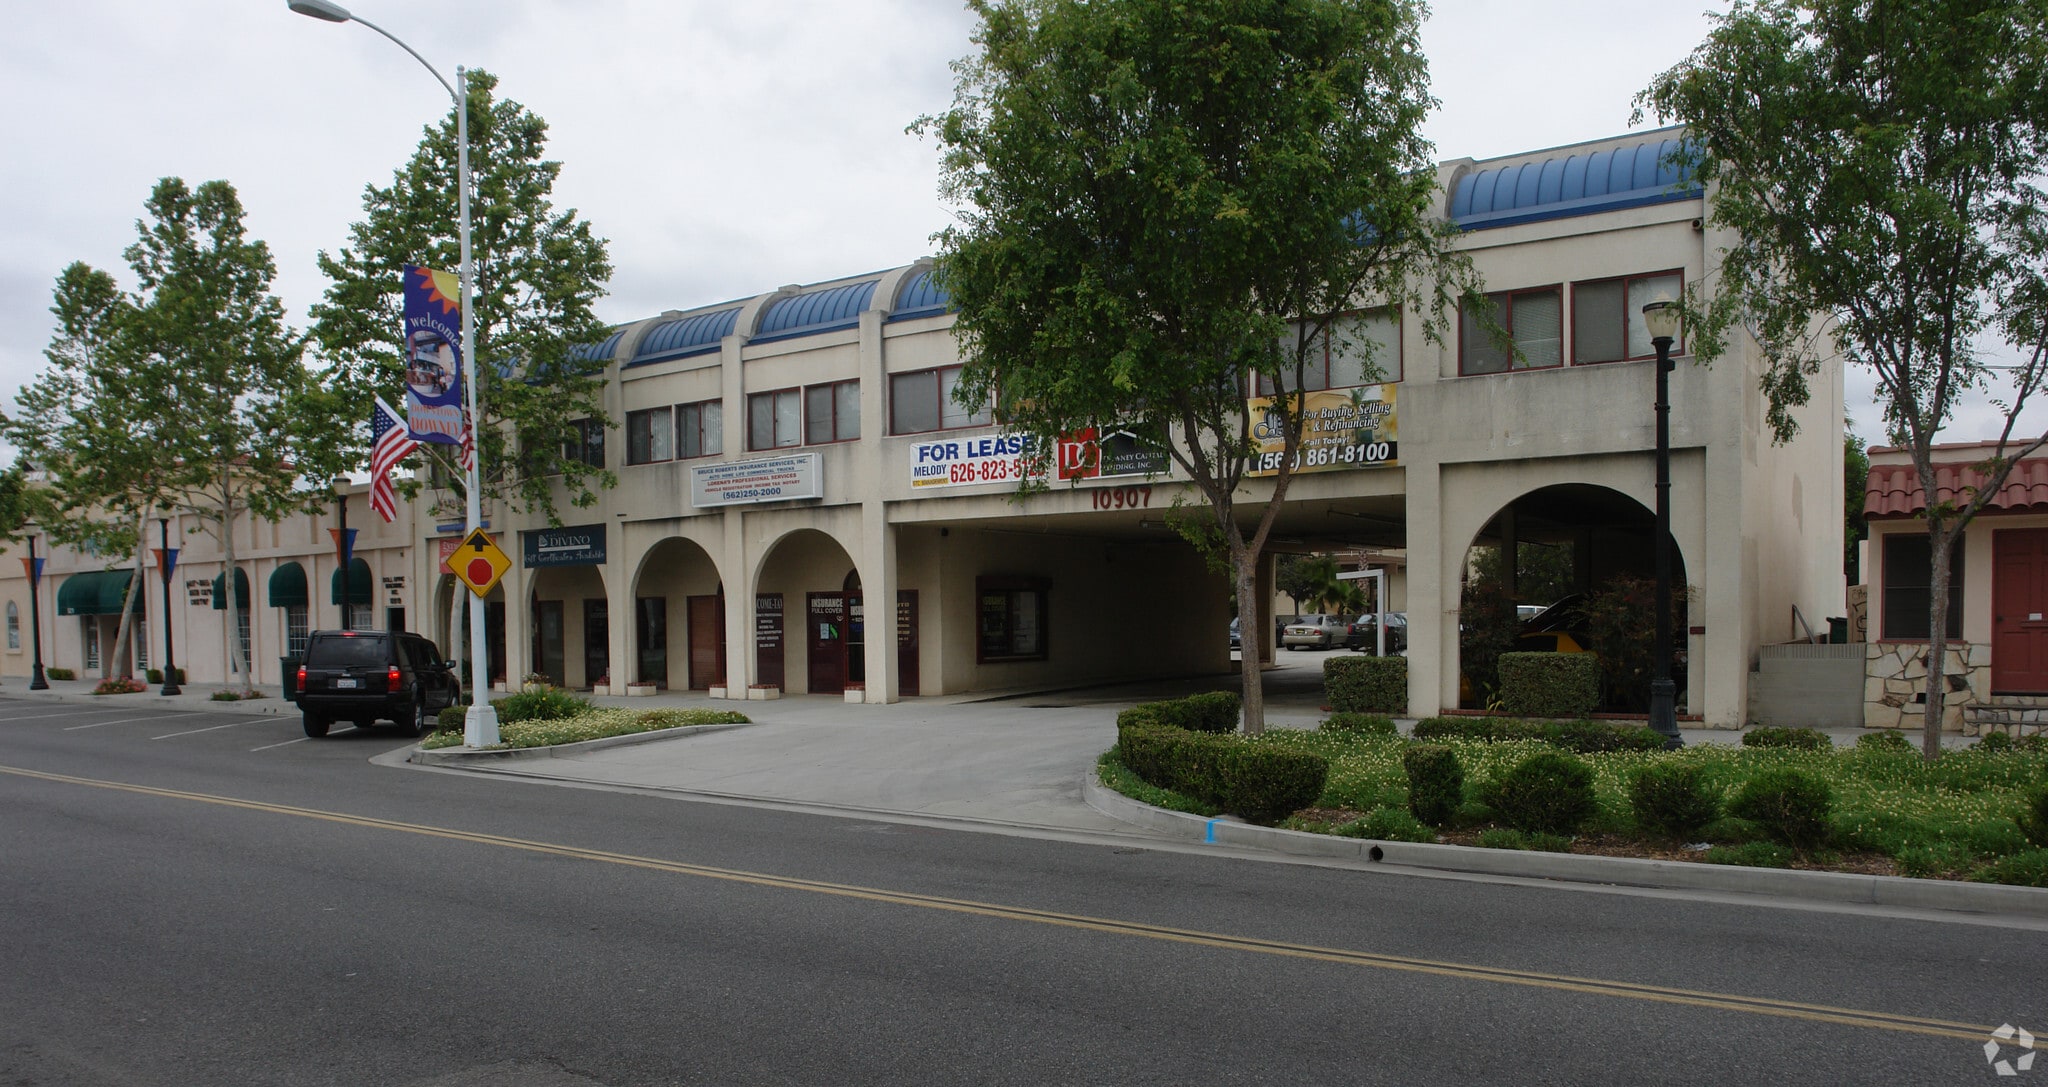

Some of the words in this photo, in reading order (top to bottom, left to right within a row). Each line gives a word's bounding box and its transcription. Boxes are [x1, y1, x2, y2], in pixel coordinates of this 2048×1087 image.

[410, 312, 460, 347] welcome
[1303, 409, 1318, 420] For
[1321, 405, 1355, 420] Buying,
[1358, 402, 1391, 416] Selling
[1313, 422, 1321, 432] &
[1324, 416, 1379, 433] Refinancing
[1323, 436, 1350, 445] Today!
[919, 443, 959, 463] FOR
[967, 434, 1036, 459] LEASE
[1306, 442, 1390, 467] 861-8100
[738, 462, 767, 470] INSURANCE
[769, 460, 795, 468] SERVICES,
[914, 464, 947, 477] MELODY
[732, 475, 769, 484] PROFESSIONAL
[723, 487, 781, 500] (562)250-2000
[1092, 487, 1152, 510] 10907
[550, 535, 591, 547] DIVINO
[811, 598, 843, 607] INSURANCE
